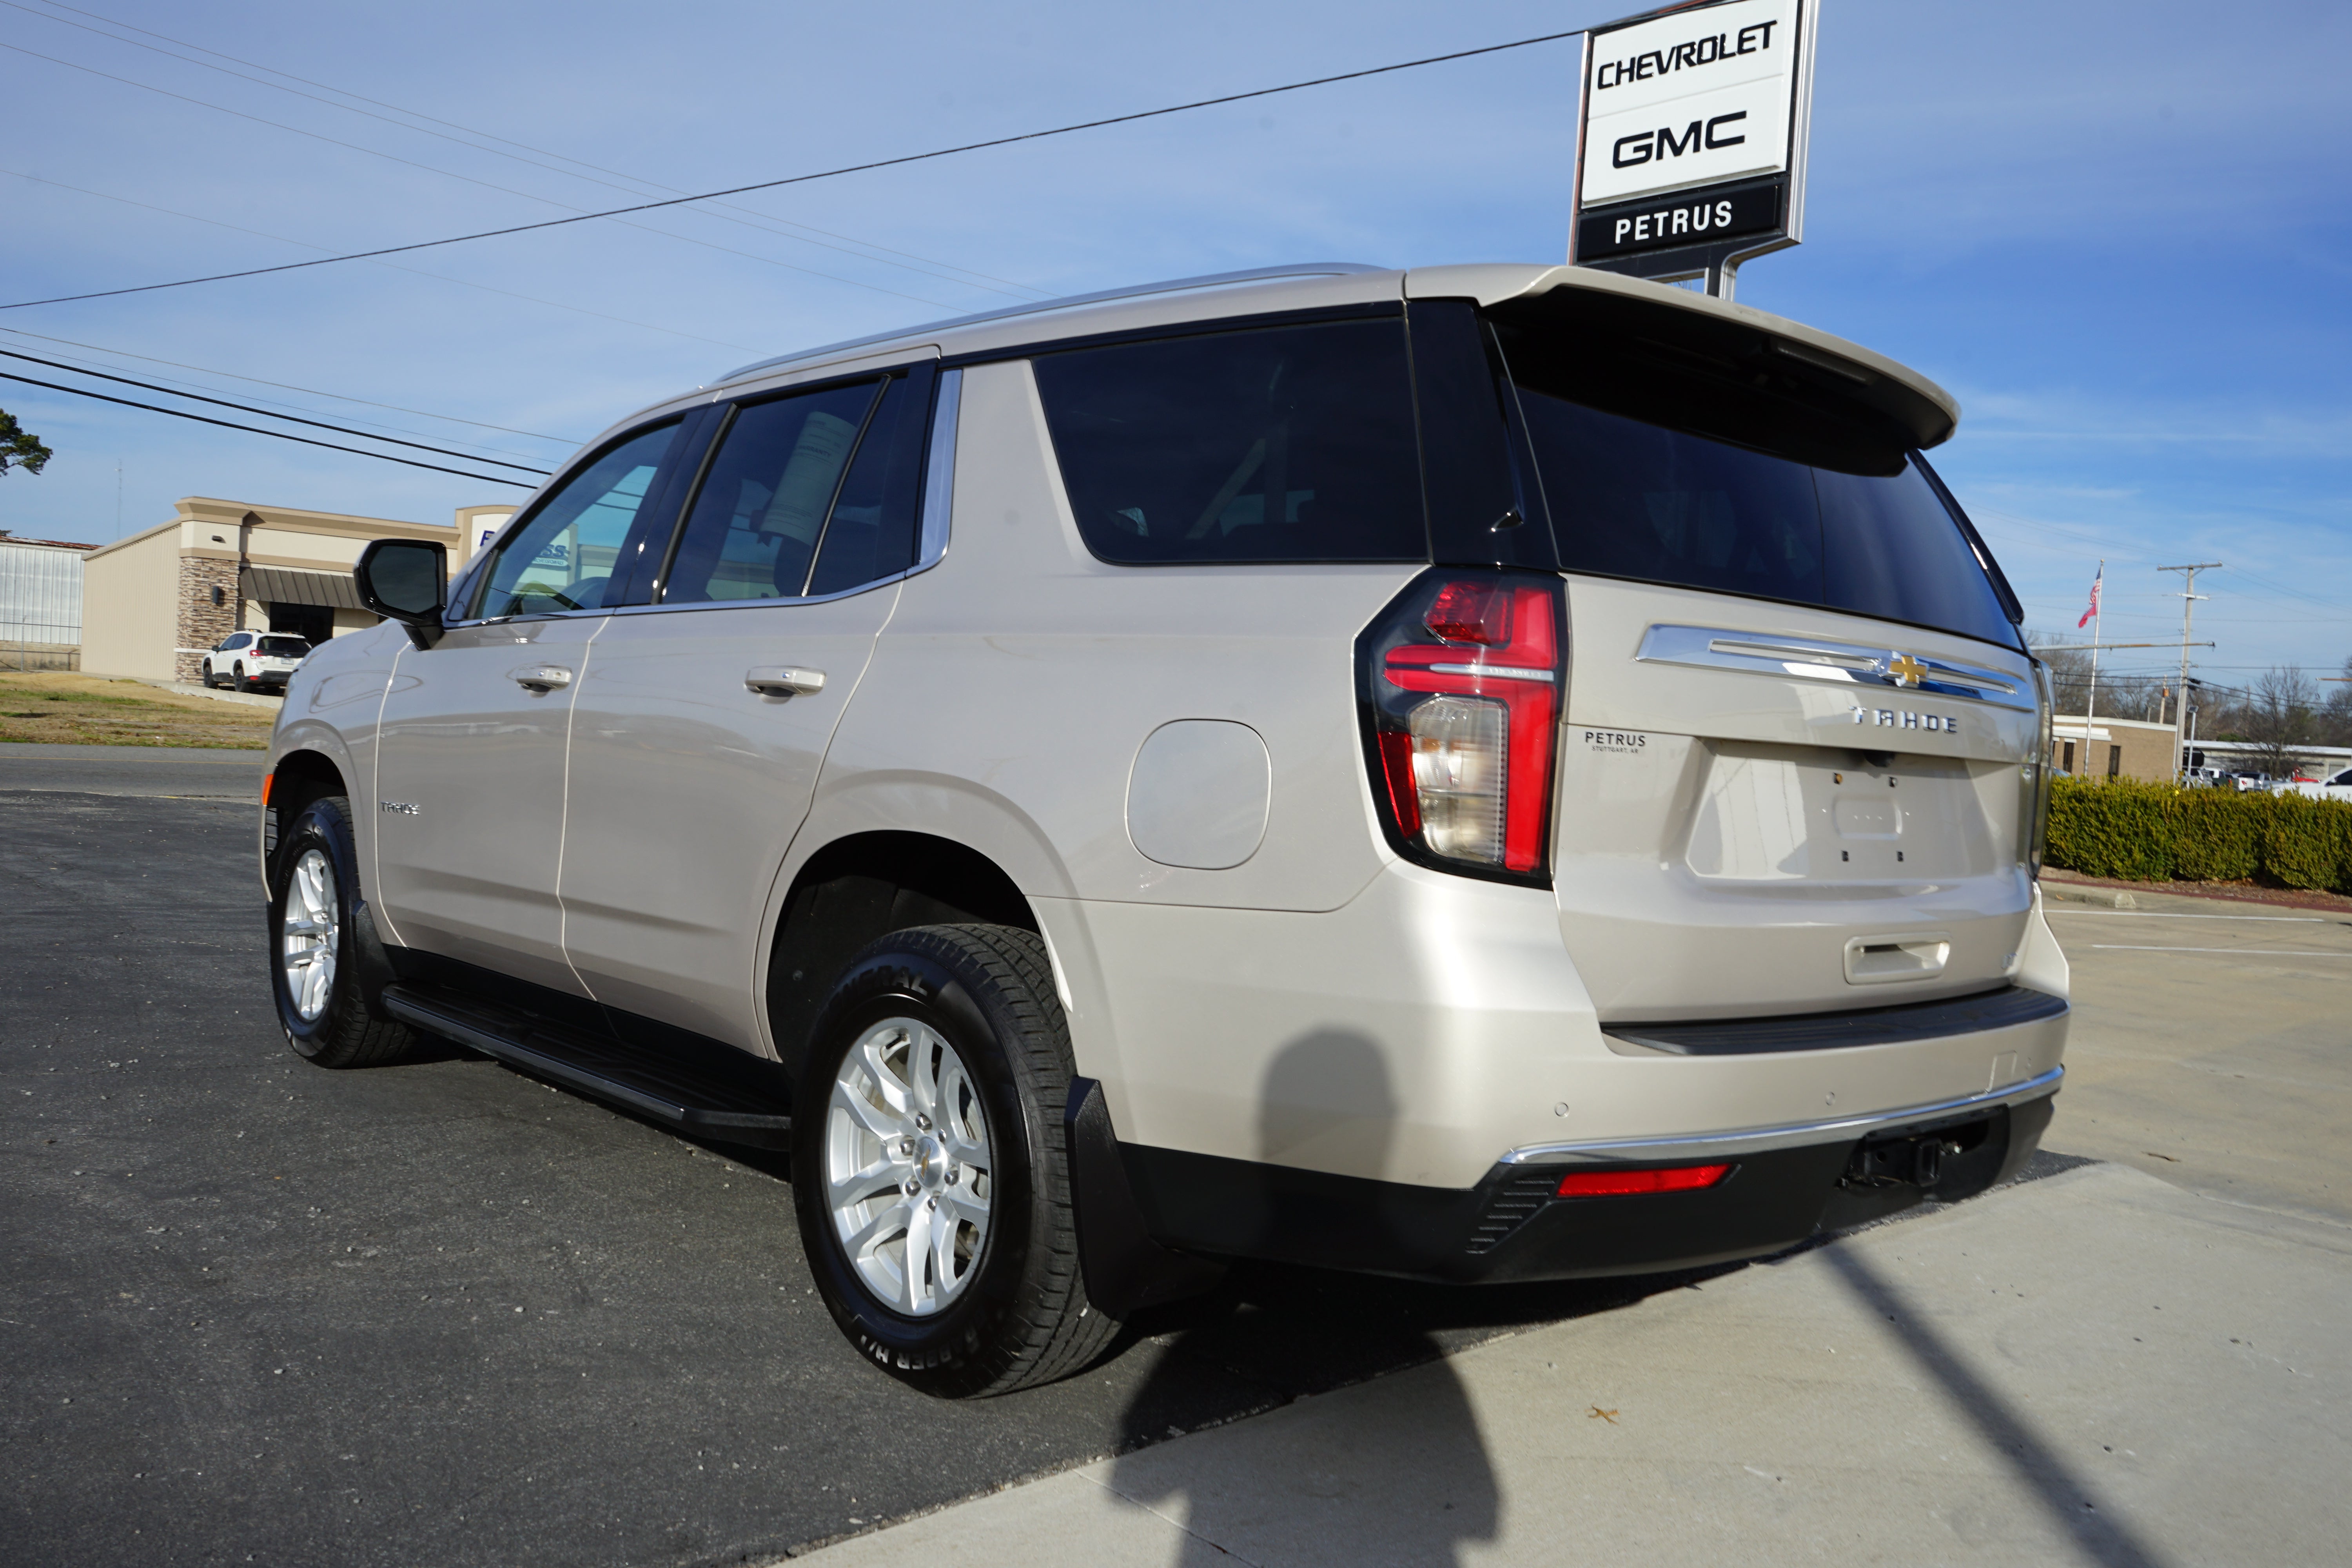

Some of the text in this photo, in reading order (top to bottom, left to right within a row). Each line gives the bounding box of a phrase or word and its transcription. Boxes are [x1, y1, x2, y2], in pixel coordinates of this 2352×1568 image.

[1597, 20, 1778, 89] CHEVROLET
[1612, 111, 1747, 169] GMC
[1615, 200, 1732, 244] PETRUS
[1585, 731, 1646, 747] PETRUS
[1849, 706, 1958, 734] TAHOE
